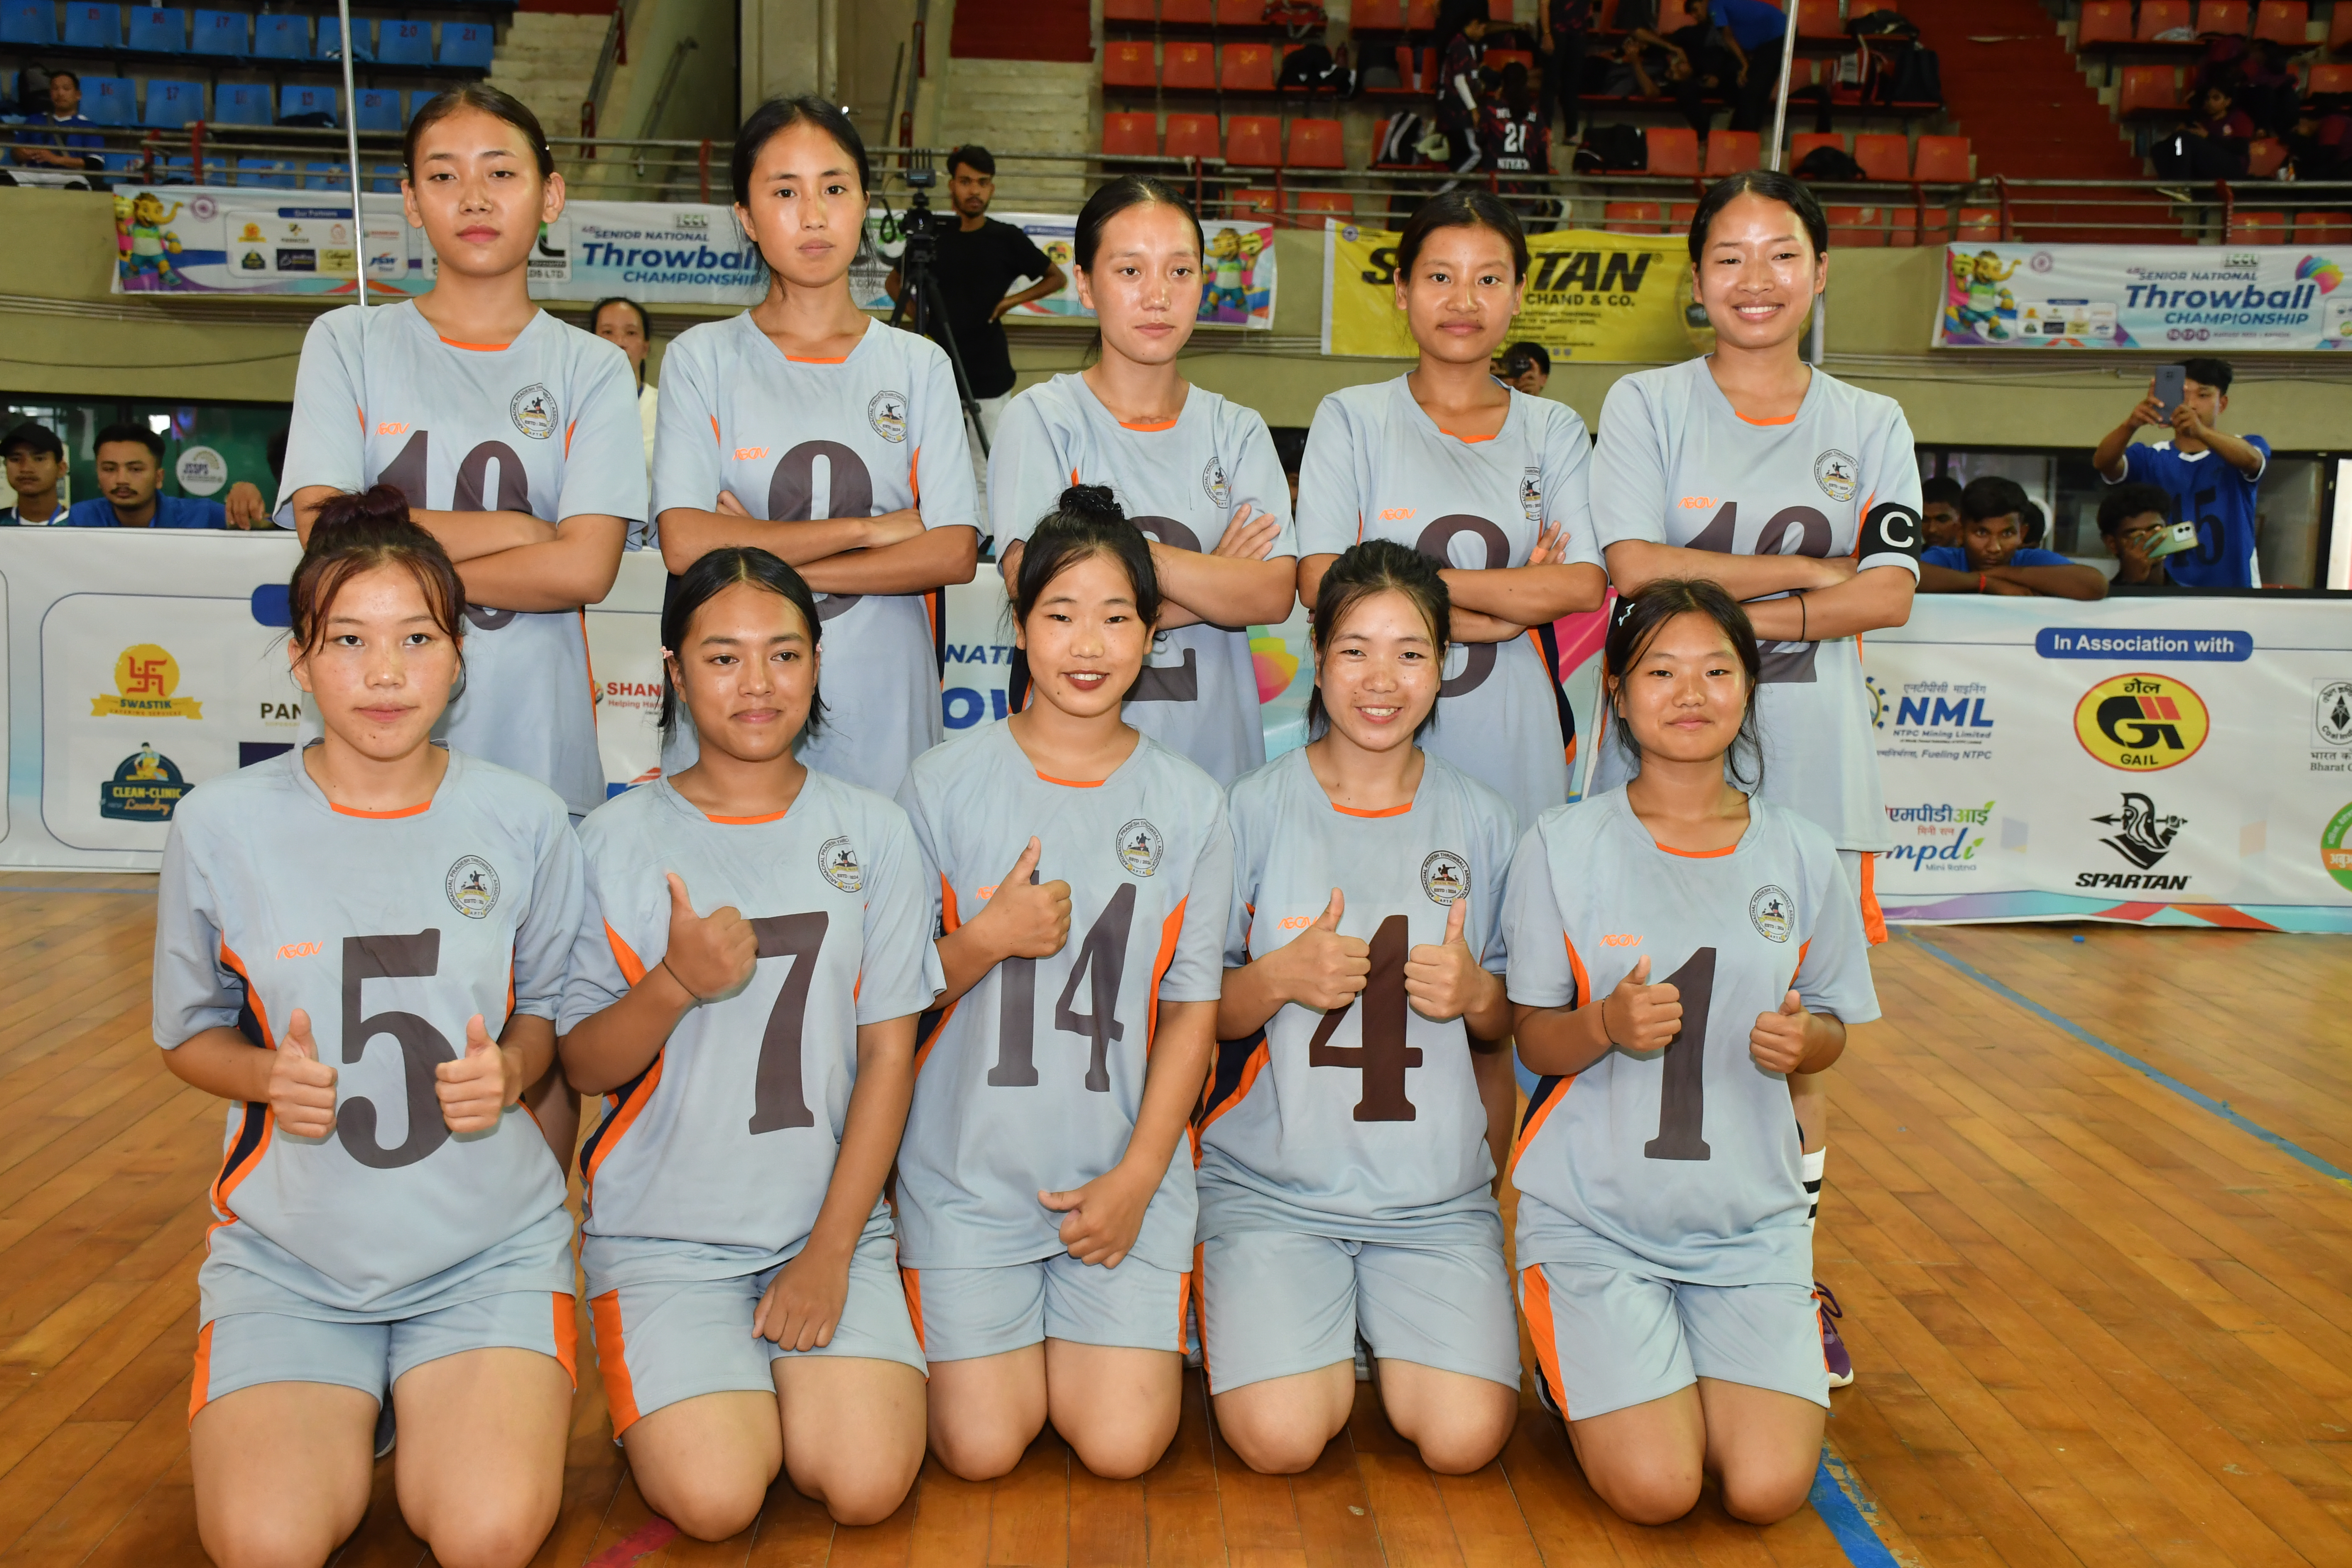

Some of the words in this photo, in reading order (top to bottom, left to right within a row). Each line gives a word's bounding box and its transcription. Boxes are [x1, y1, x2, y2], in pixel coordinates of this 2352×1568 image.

[400, 25, 417, 37] 20
[463, 28, 476, 41] 21
[1504, 122, 1527, 153] 21
[595, 230, 642, 240] SENIOR
[645, 231, 709, 242] NATIONAL
[583, 242, 754, 269] Throwbal
[2139, 272, 2187, 280] SENIOR
[2191, 272, 2257, 281] NATIONAL
[1526, 294, 1584, 305] CHAND
[1590, 295, 1601, 305] &
[1608, 294, 1635, 306] CO.
[2125, 283, 2316, 310] Throwball
[2164, 311, 2309, 326] CHAMPIONSHIP
[871, 393, 884, 407] PRADES
[885, 393, 906, 403] THROWBA
[1880, 511, 1914, 548] C
[2054, 634, 2071, 650] In
[2076, 634, 2189, 652] Association
[2194, 637, 2234, 653] with
[945, 645, 1015, 665] NATI
[607, 682, 661, 696] SHAN
[2123, 678, 2161, 694] गेल
[121, 699, 172, 709] SWASTIK
[261, 703, 301, 719] PAN
[608, 700, 640, 709] Helping
[1896, 697, 1994, 727] NML
[1922, 730, 1952, 739] Mining
[1922, 749, 1960, 760] Fueling
[1962, 751, 1993, 760] NTPC
[2121, 754, 2159, 765] GAIL
[2311, 762, 2344, 771] Bharat
[113, 787, 182, 798] CLEAN-CLINIC
[1885, 801, 1995, 826] एमपीडीआई
[1121, 821, 1140, 836] PRADESH
[821, 841, 836, 855] PRADESH
[1118, 837, 1129, 865] ARUNACHAL
[1874, 827, 1985, 872] mpdi
[450, 858, 470, 877] PRADESH
[471, 858, 495, 878] THROWBALL
[1424, 854, 1439, 868] PRADESH
[1440, 852, 1466, 870] THROWBALL
[820, 856, 838, 884] ARUNACHAL
[1423, 868, 1434, 898] ARUNACHAL
[2075, 873, 2188, 890] SPARTAN
[448, 879, 464, 910] ARUNACHAL
[1753, 888, 1771, 903] PRADESH
[1751, 904, 1765, 932] ARUNACHAL
[988, 870, 1136, 1092] 14
[749, 911, 829, 1135] 7
[1309, 915, 1423, 1122] 4
[337, 928, 458, 1169] 5
[1644, 947, 1717, 1161] 1
